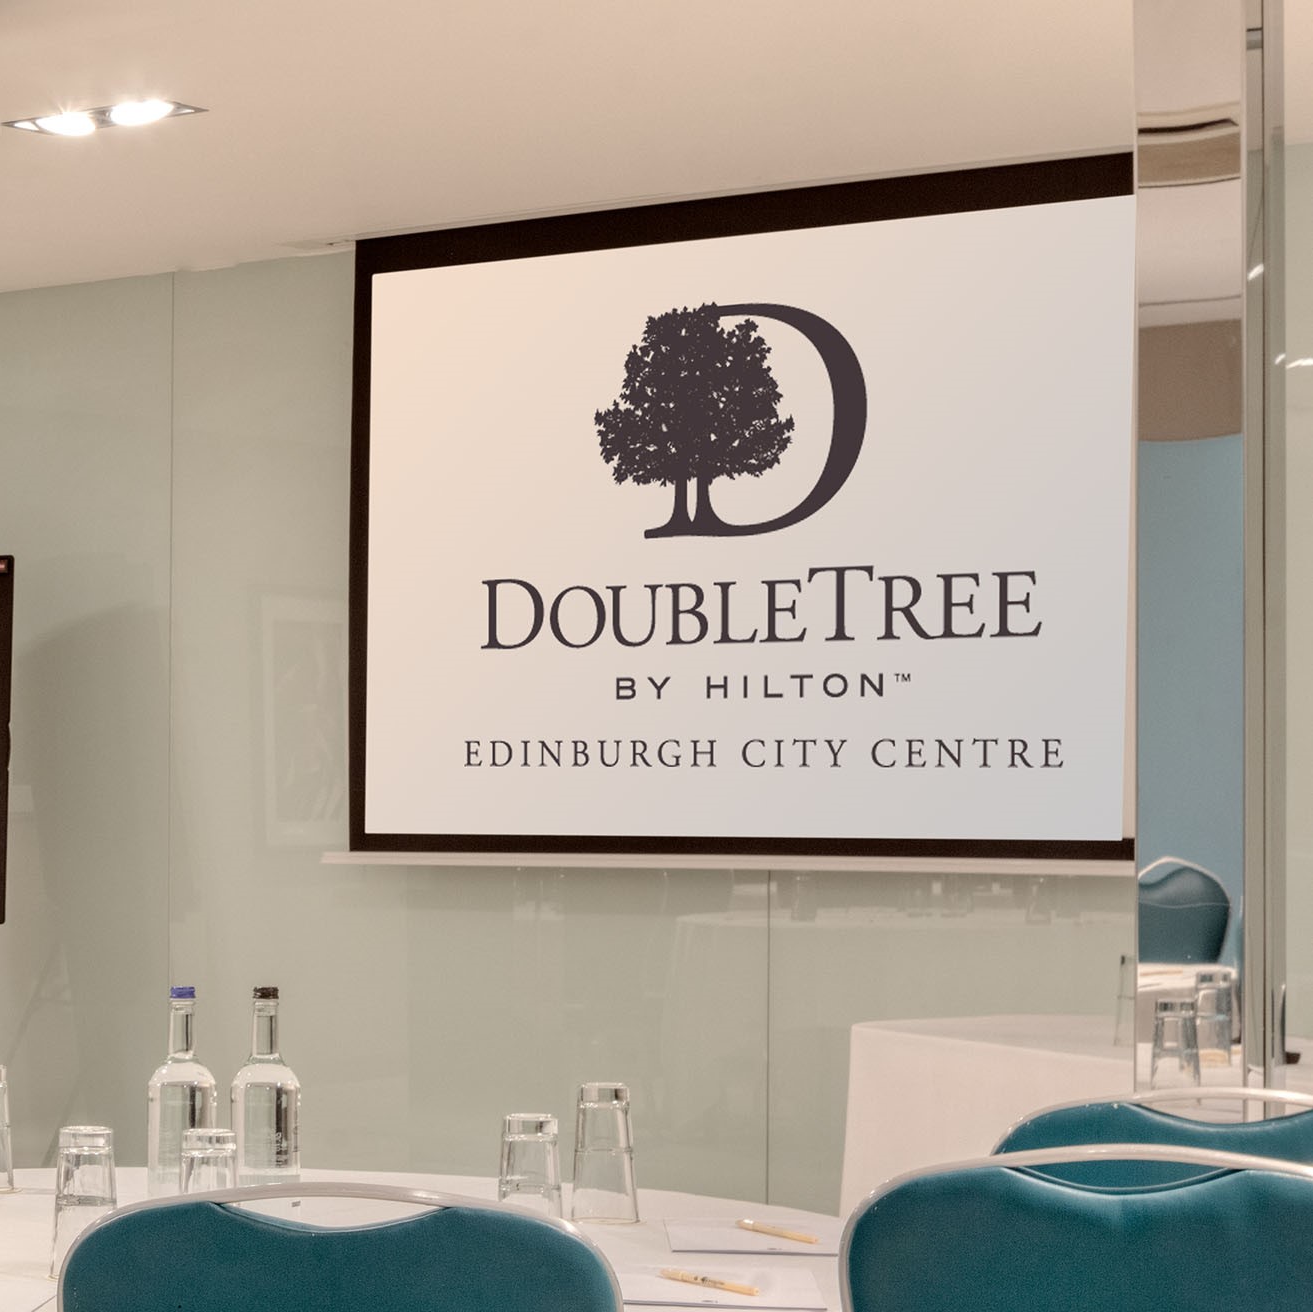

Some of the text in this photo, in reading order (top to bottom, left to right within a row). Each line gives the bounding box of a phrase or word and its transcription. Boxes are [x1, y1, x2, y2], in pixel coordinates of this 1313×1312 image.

[480, 565, 1043, 650] DOUBLETREE
[615, 676, 671, 700] BY
[464, 737, 1064, 769] EDINBURGH CITY CENTRE
